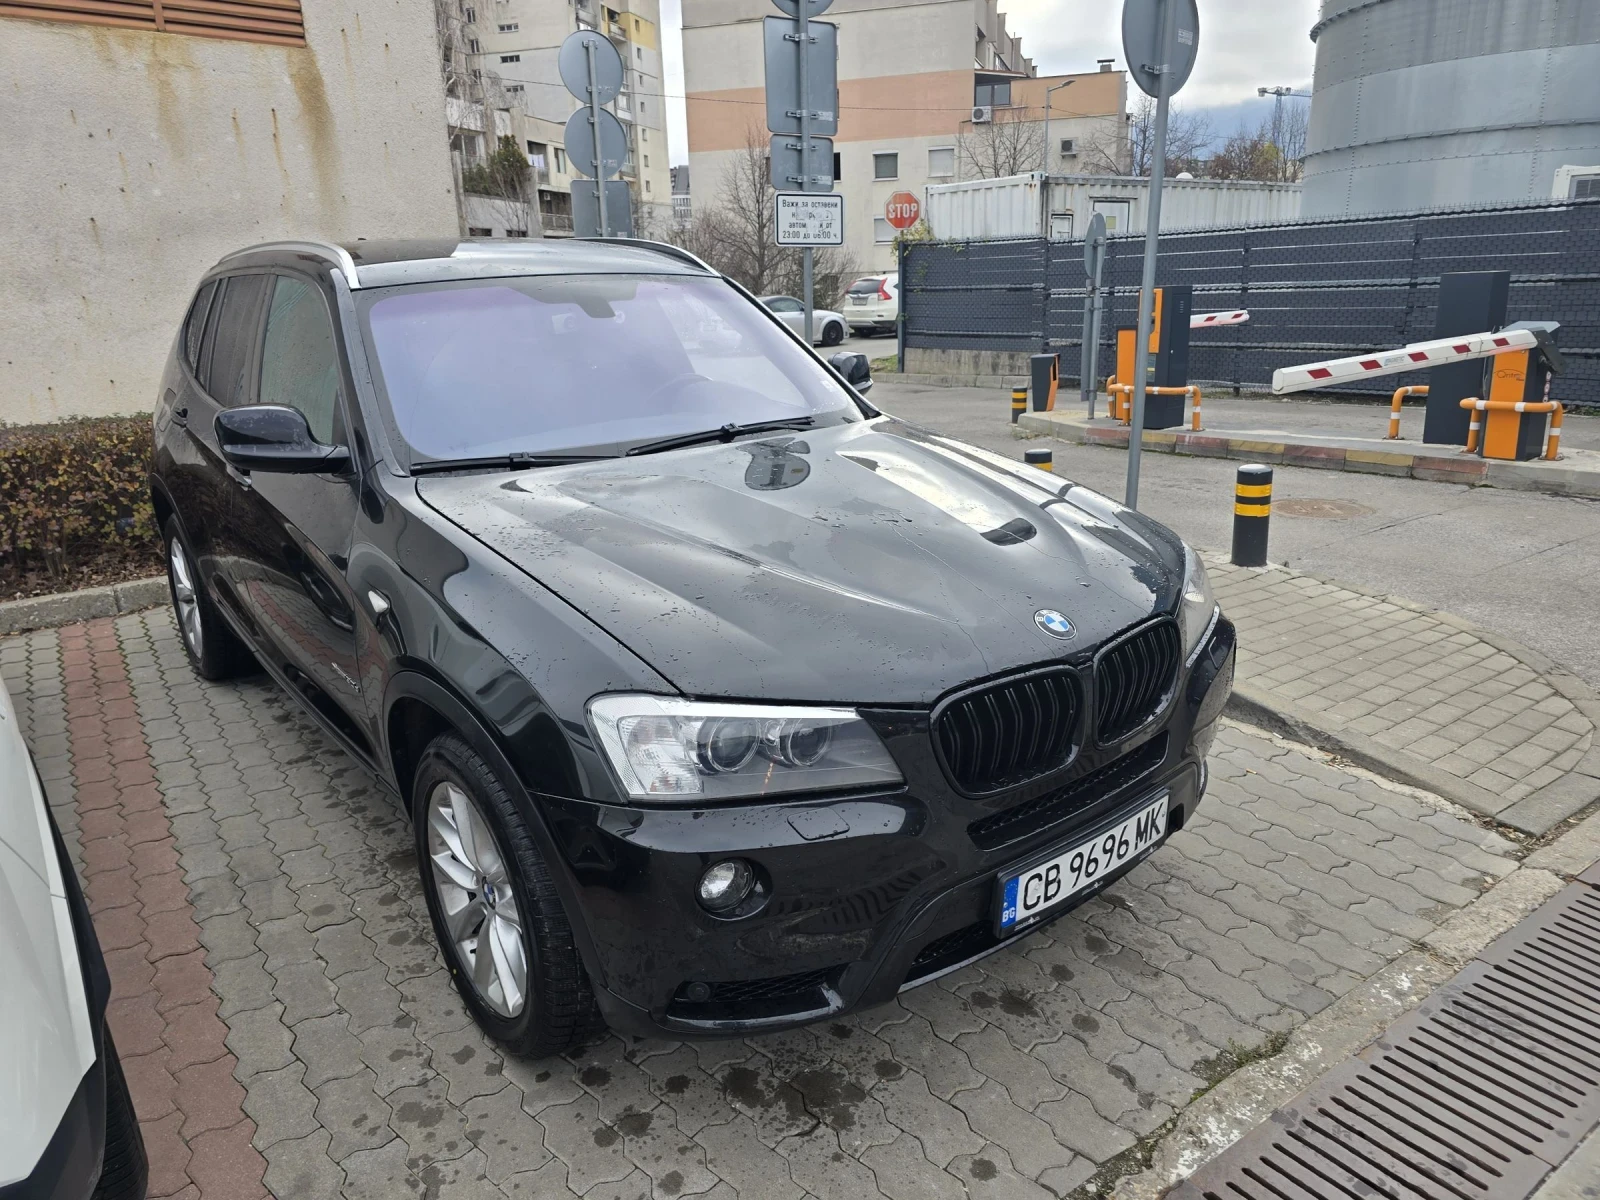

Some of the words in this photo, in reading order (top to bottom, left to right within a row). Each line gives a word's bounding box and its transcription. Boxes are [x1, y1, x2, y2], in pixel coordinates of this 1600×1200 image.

[782, 199, 799, 208] Важи
[888, 203, 918, 219] STOP
[782, 230, 801, 239] 23:00
[1023, 863, 1062, 911] CB
[1069, 824, 1130, 889] 9696
[1134, 802, 1164, 851] MK
[1002, 907, 1016, 923] BG
